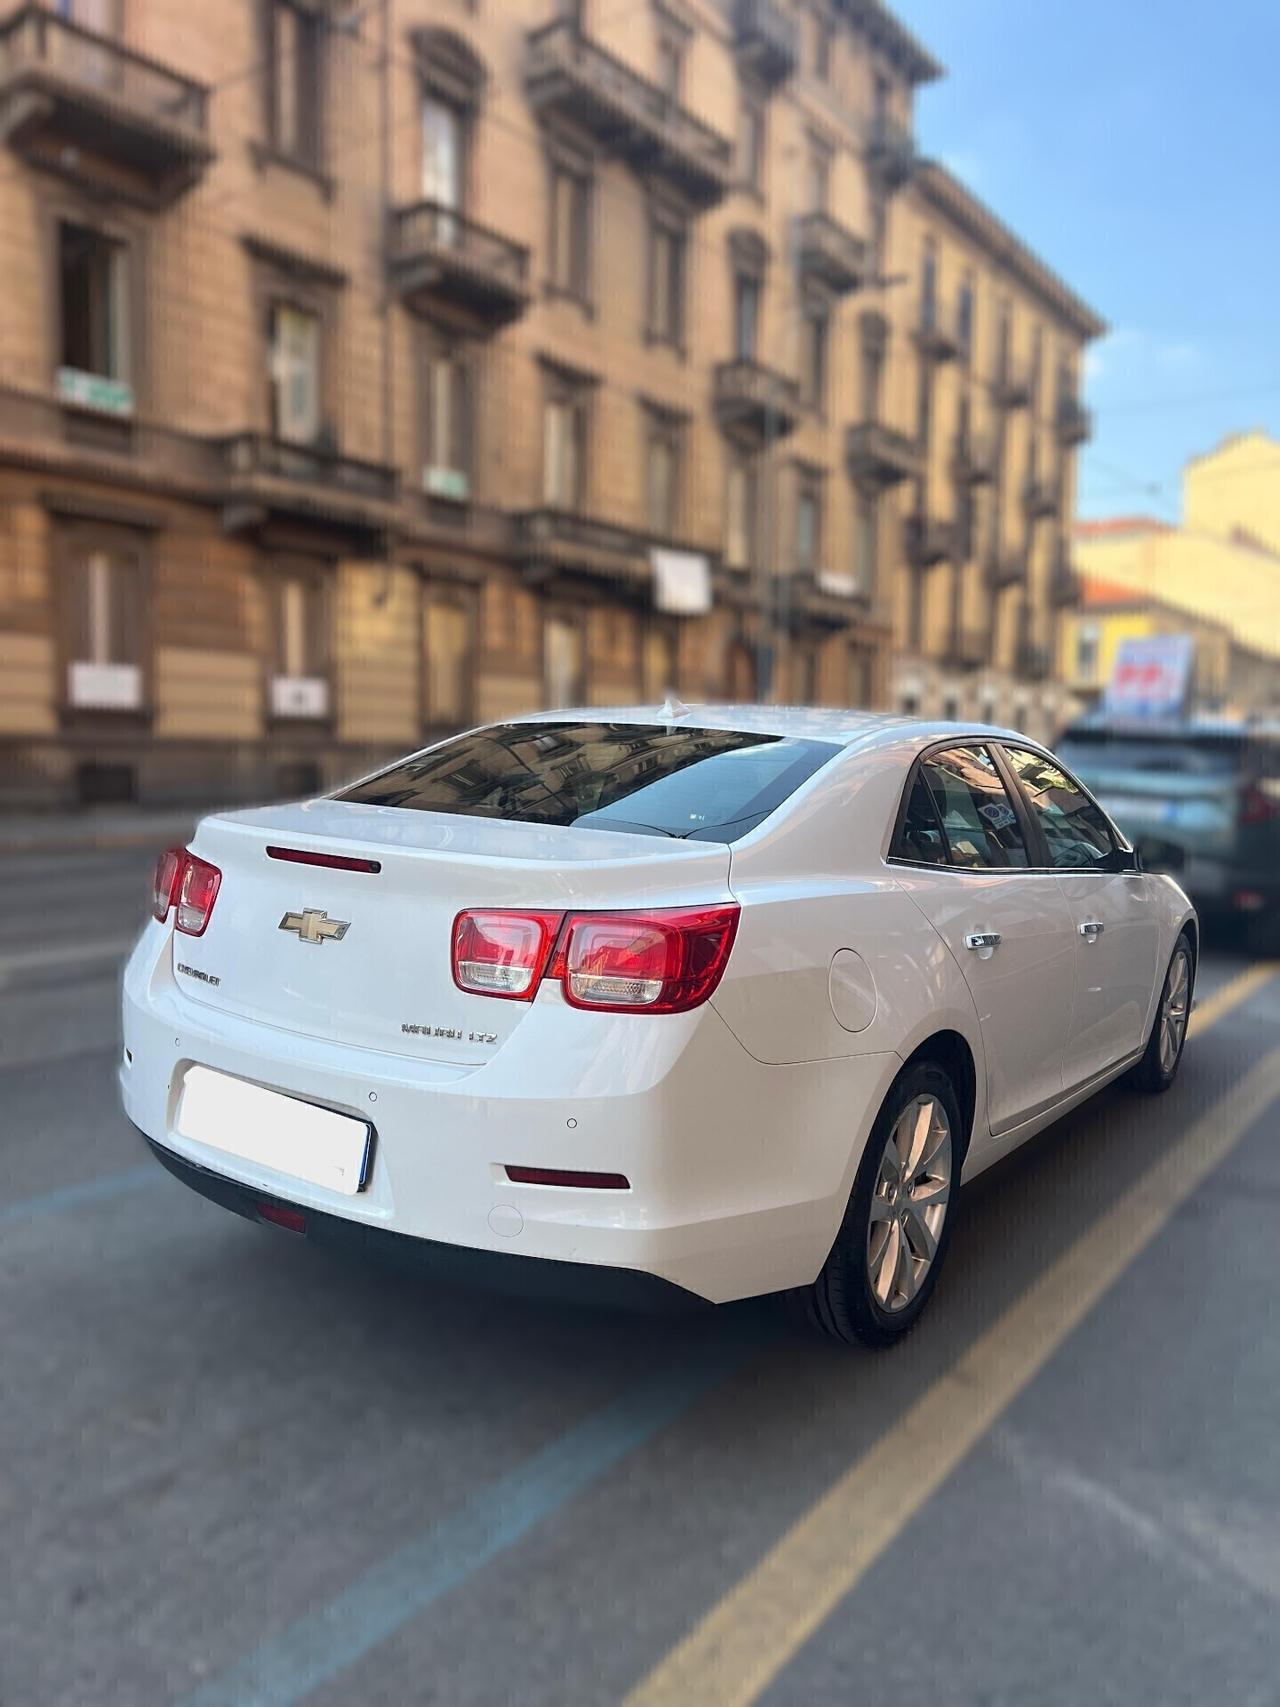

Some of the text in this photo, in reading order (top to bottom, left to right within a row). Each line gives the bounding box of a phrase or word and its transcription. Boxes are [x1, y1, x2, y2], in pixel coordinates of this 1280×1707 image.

[177, 962, 221, 988] CHEVROLET
[401, 1023, 498, 1044] MALIBU LTZ
